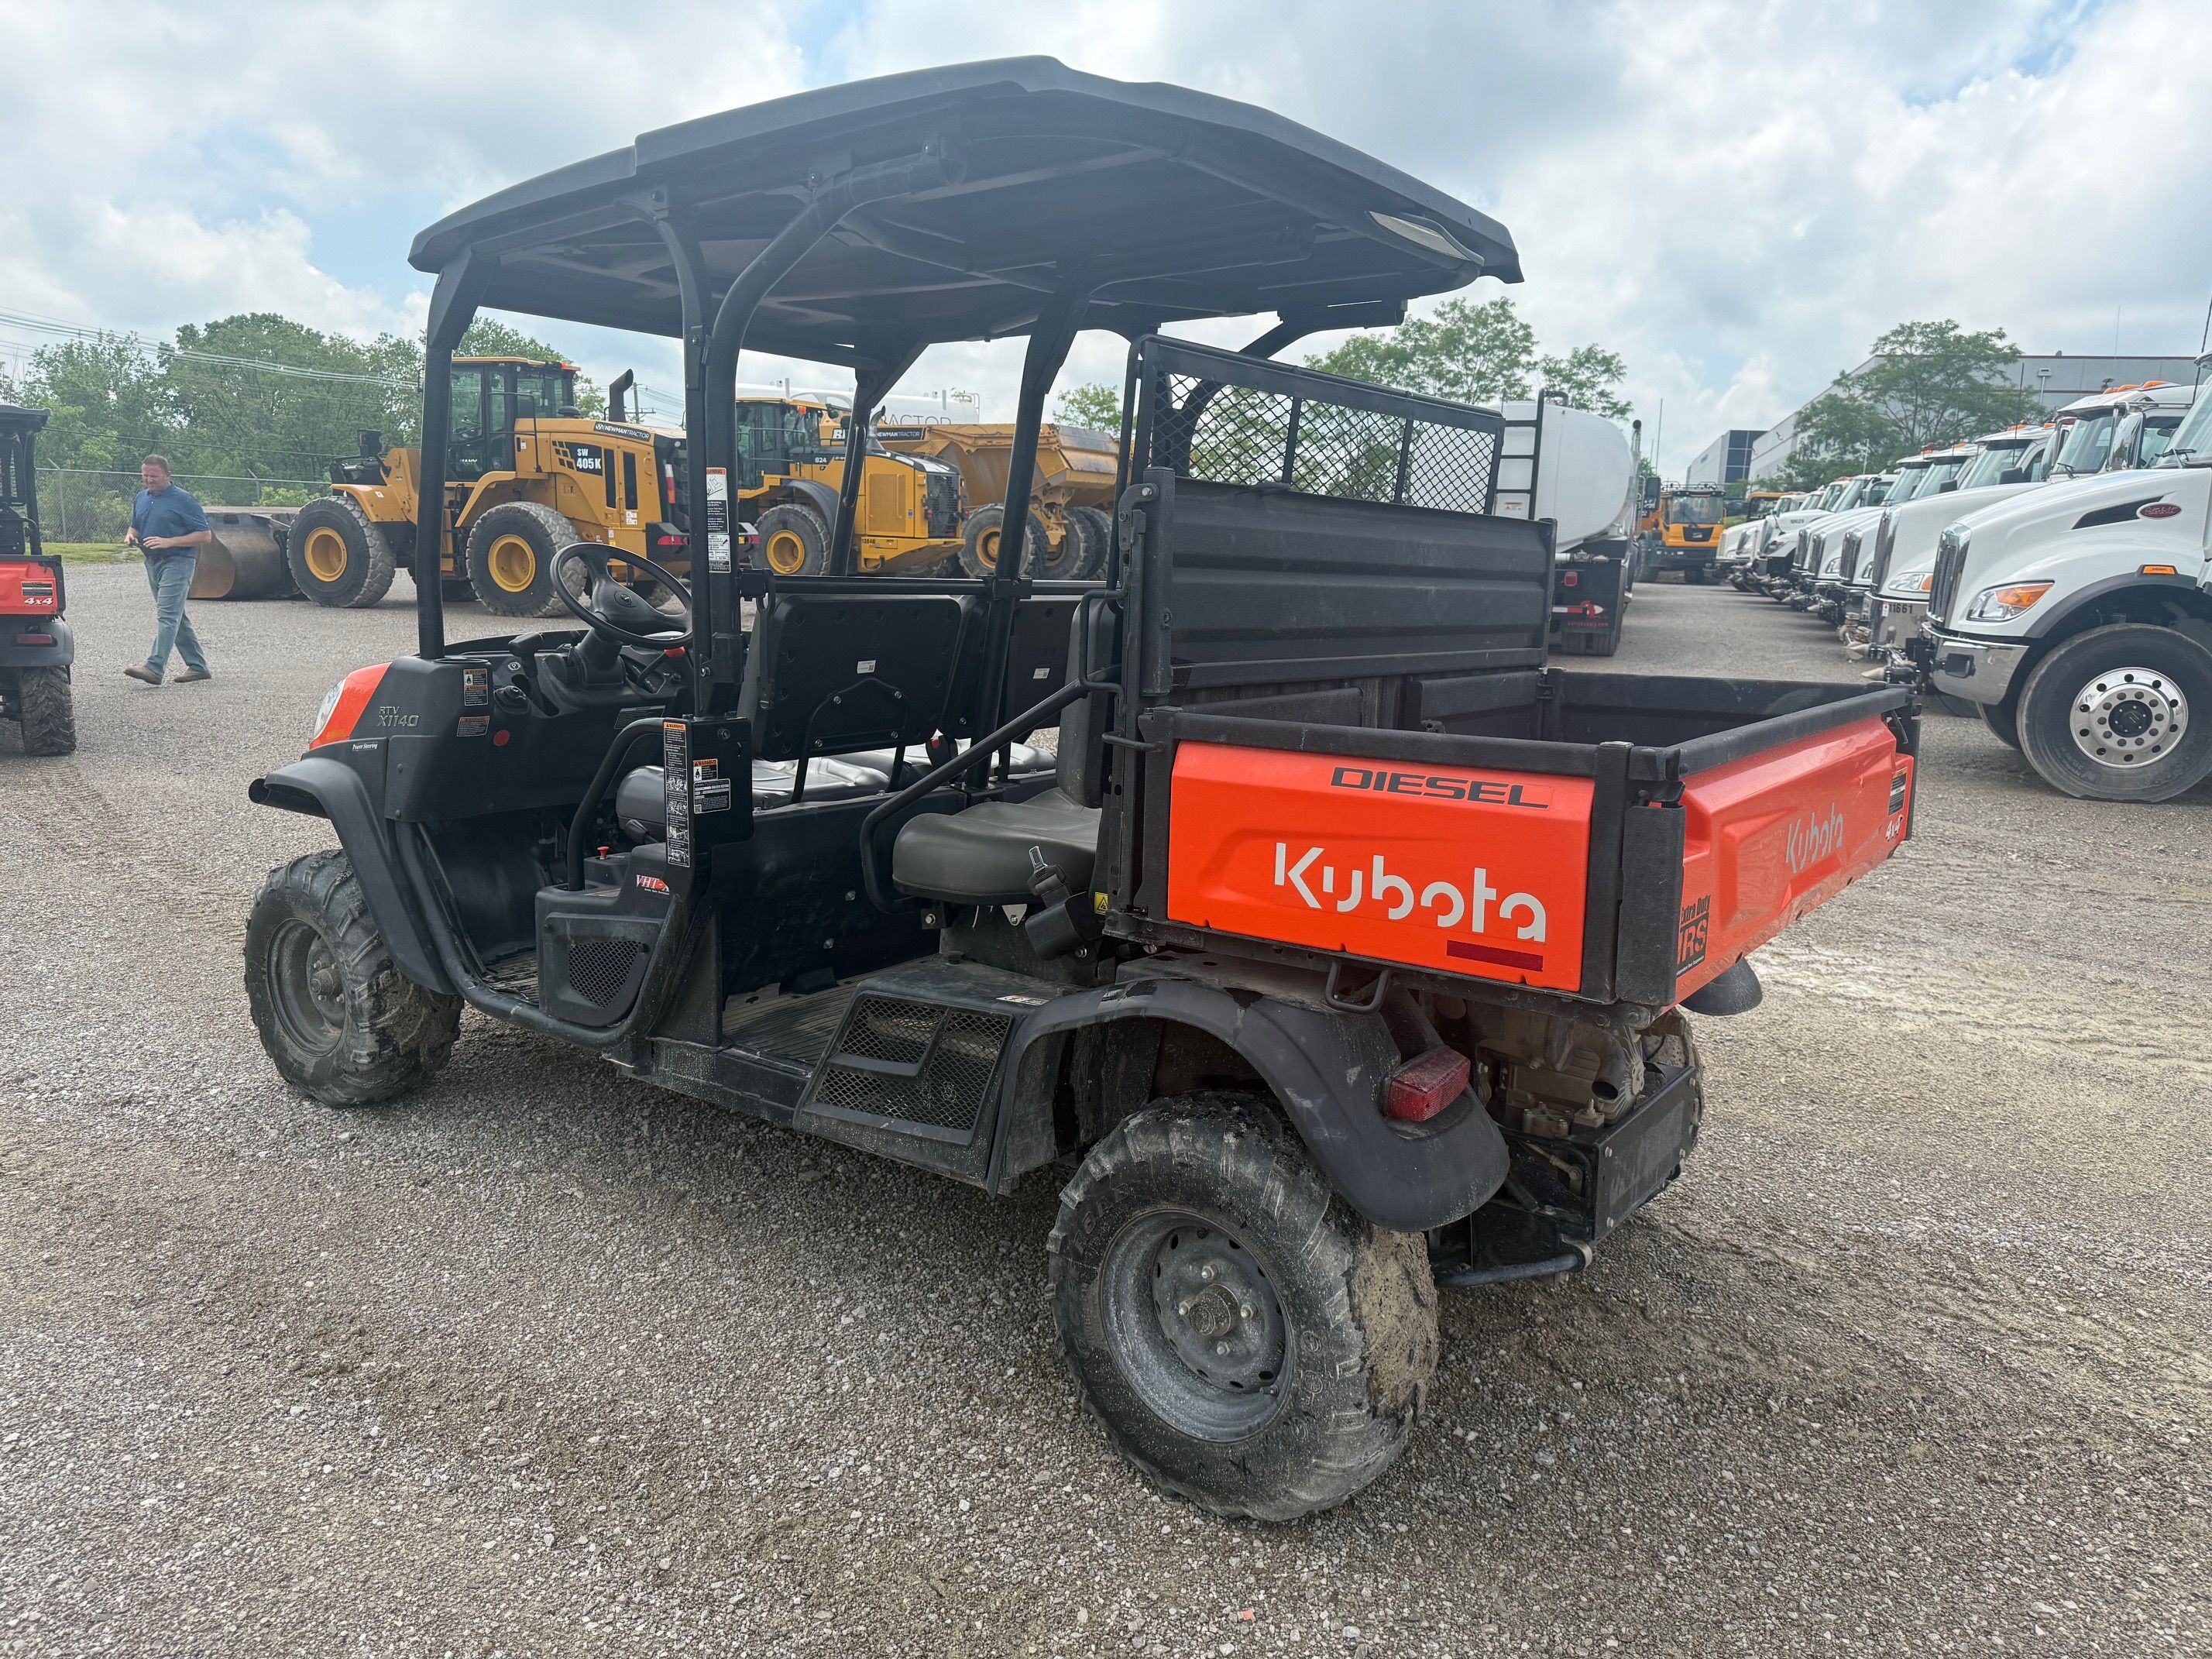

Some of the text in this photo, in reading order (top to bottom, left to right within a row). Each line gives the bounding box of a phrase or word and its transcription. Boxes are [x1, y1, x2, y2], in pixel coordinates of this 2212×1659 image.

[605, 425, 651, 439] NEWMANTRACTOR
[577, 448, 589, 457] SW
[576, 458, 602, 469] 405K
[379, 706, 400, 714] RTV
[376, 715, 420, 727] X1140
[1330, 766, 1550, 809] DIESEL
[1784, 802, 1843, 874] Kubota
[1274, 842, 1547, 943] Kubota
[1680, 903, 1696, 925] Extra
